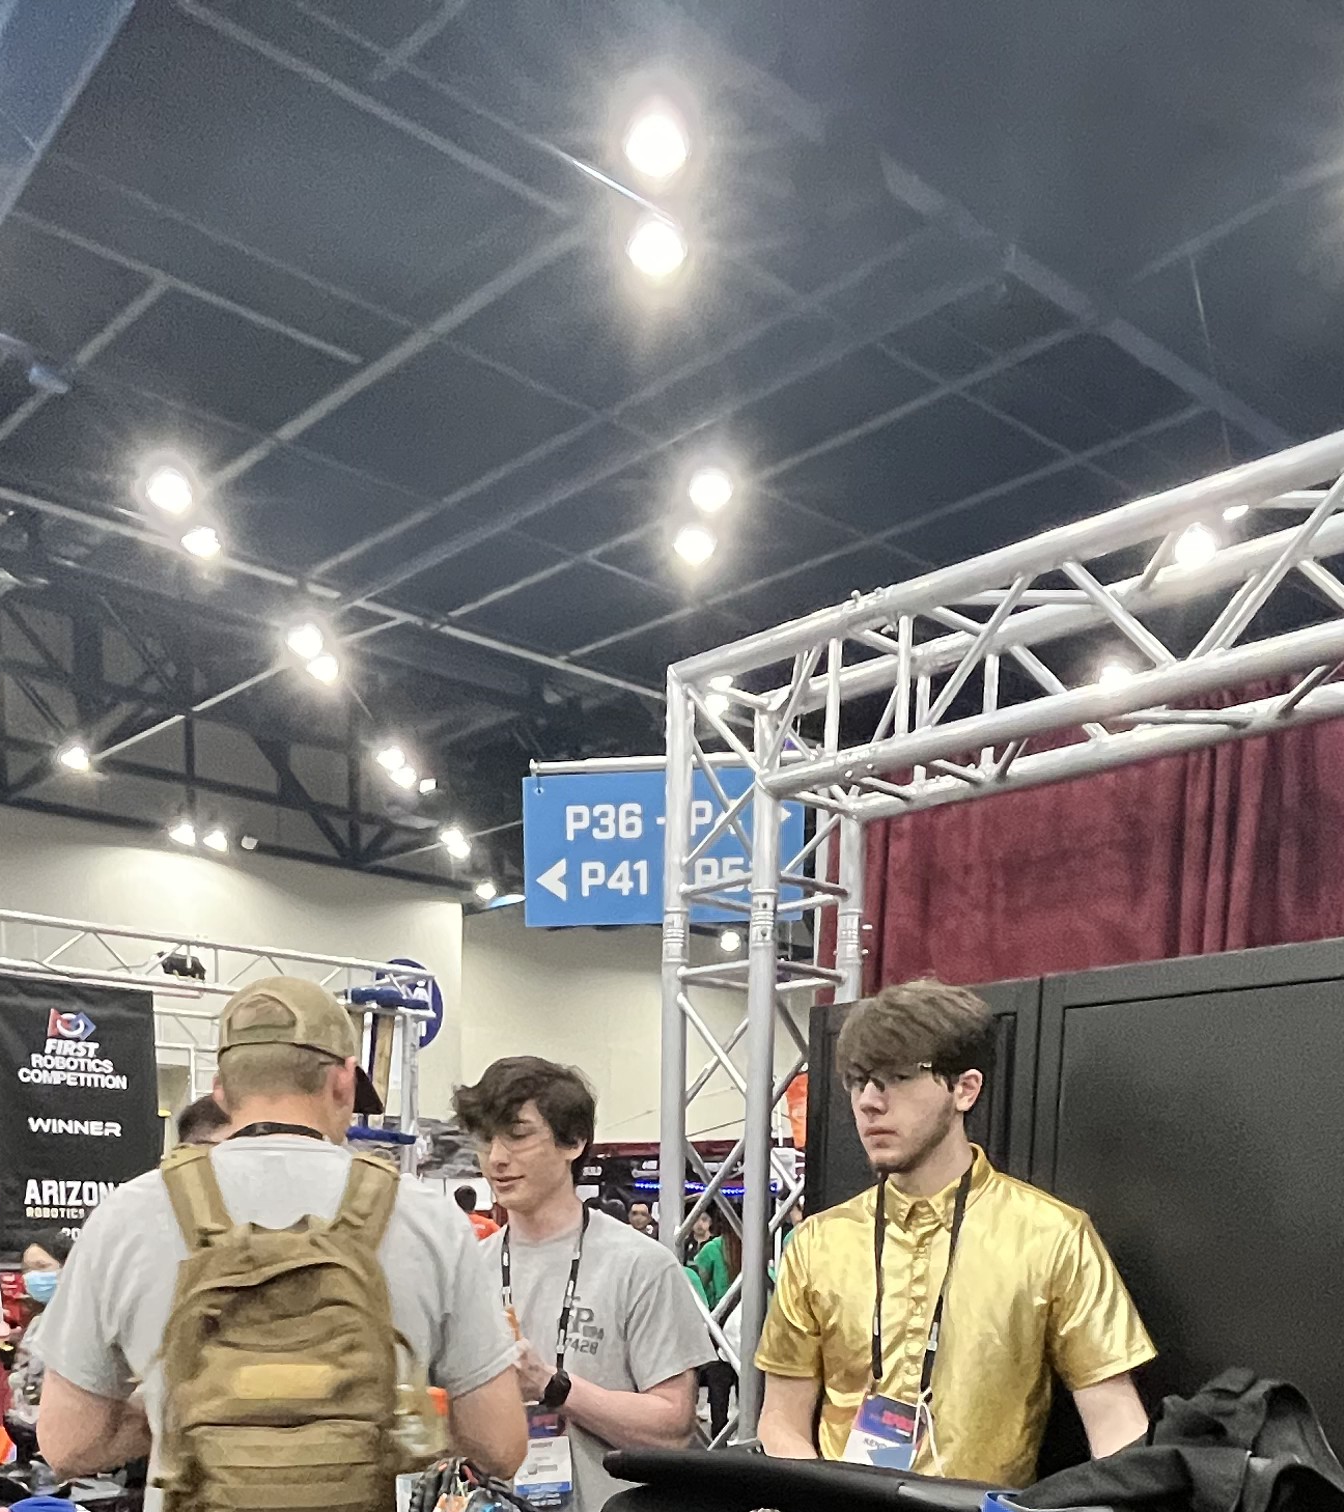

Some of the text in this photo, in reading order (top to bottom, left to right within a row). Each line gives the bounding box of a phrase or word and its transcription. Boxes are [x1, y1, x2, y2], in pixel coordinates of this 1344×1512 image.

[565, 802, 643, 841] P36
[581, 856, 754, 897] P41 P5
[44, 1038, 100, 1058] FIRST
[31, 1053, 114, 1074] ROBOTICS
[17, 1067, 128, 1090] COMPETITION
[28, 1116, 122, 1137] WINNER
[23, 1178, 123, 1207] ARIZON
[25, 1206, 85, 1219] ROBOTICS
